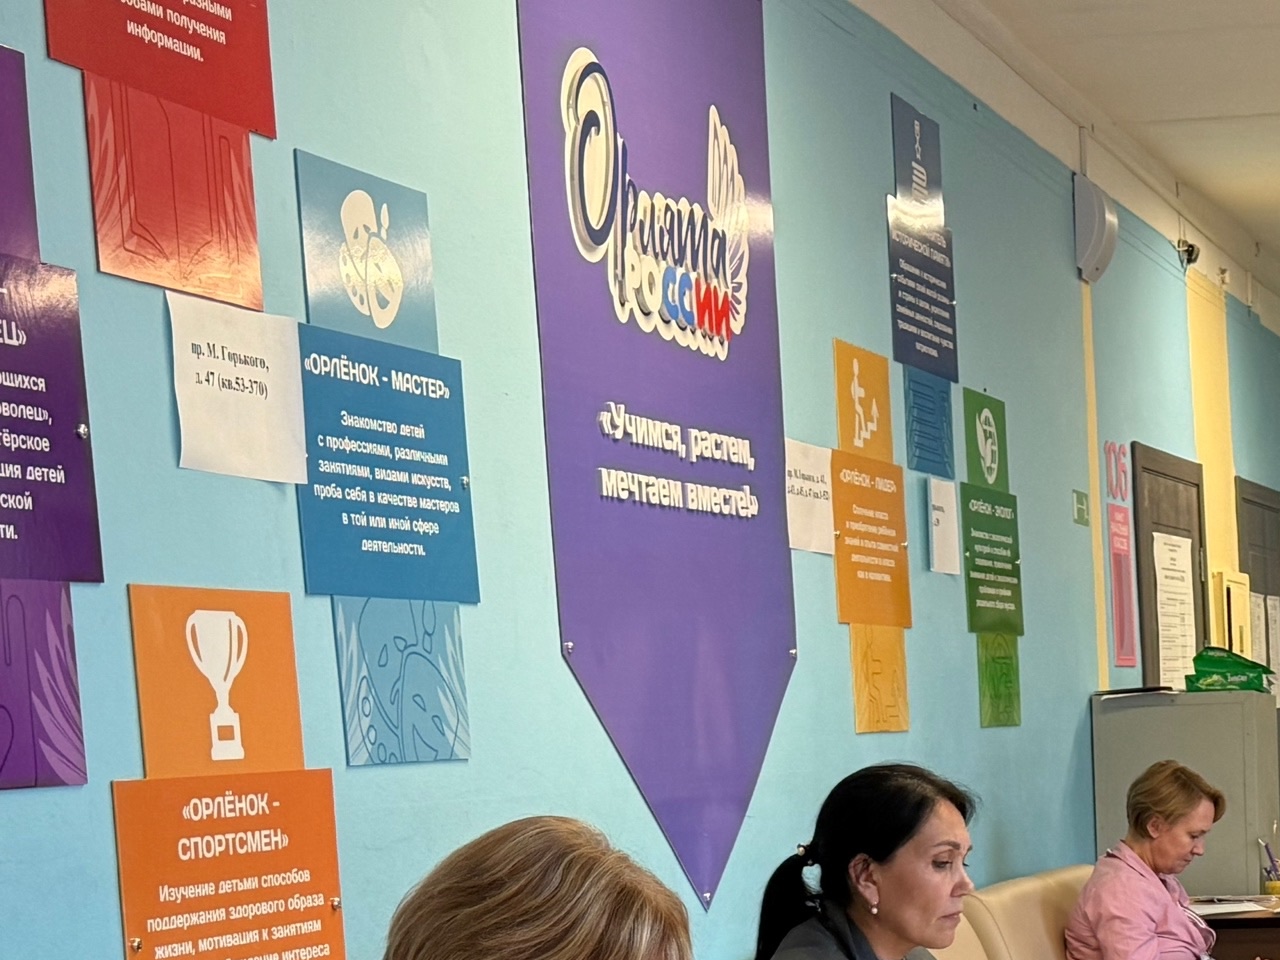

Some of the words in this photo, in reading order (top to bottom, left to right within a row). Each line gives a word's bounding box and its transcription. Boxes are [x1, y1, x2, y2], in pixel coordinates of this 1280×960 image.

[127, 20, 204, 62] информации.
[166, 8, 226, 44] получения
[625, 242, 733, 341] РОССИИ
[191, 342, 205, 358] пр.
[207, 342, 220, 360] М.
[221, 346, 270, 374] Горького,
[0, 371, 46, 392] щихся
[204, 371, 216, 388] 47
[304, 352, 380, 388] «ОРЛЁНОК
[392, 371, 450, 400] МАСТЕР»
[0, 401, 52, 426] волец»,
[340, 410, 398, 435] Знакомство
[400, 421, 425, 439] детей
[0, 428, 50, 452] ёрское
[318, 436, 324, 447] с
[326, 434, 392, 460] профессиями,
[394, 445, 448, 466] различными
[599, 402, 686, 458] «Учимся,
[688, 428, 756, 470] растем,
[26, 464, 65, 484] детей
[318, 459, 372, 482] занятиями,
[374, 466, 410, 484] видами
[411, 472, 452, 491] искусств,
[314, 483, 342, 500] проба
[344, 488, 368, 502] себя
[369, 490, 376, 502] в
[377, 492, 418, 508] качестве
[418, 497, 460, 514] мастеров
[598, 467, 683, 508] мечтаем
[685, 482, 759, 518] вместе!»
[342, 512, 348, 524] в
[350, 512, 367, 526] той
[368, 515, 386, 529] или
[388, 515, 410, 530] иной
[412, 518, 440, 535] сфере
[362, 538, 426, 556] деятельности.
[182, 790, 270, 822] «ОРЛЁНОК
[178, 828, 289, 862] СПОРТСМЕН»
[159, 881, 216, 904] Изучение
[218, 874, 258, 895] детьми
[261, 868, 310, 889] способов
[146, 906, 226, 933] поддержания
[228, 898, 286, 921] здорового
[287, 892, 324, 912] образа
[154, 939, 196, 960] жизни,
[198, 928, 260, 954] мотивация
[262, 928, 270, 940] к
[271, 918, 322, 940] занятиям
